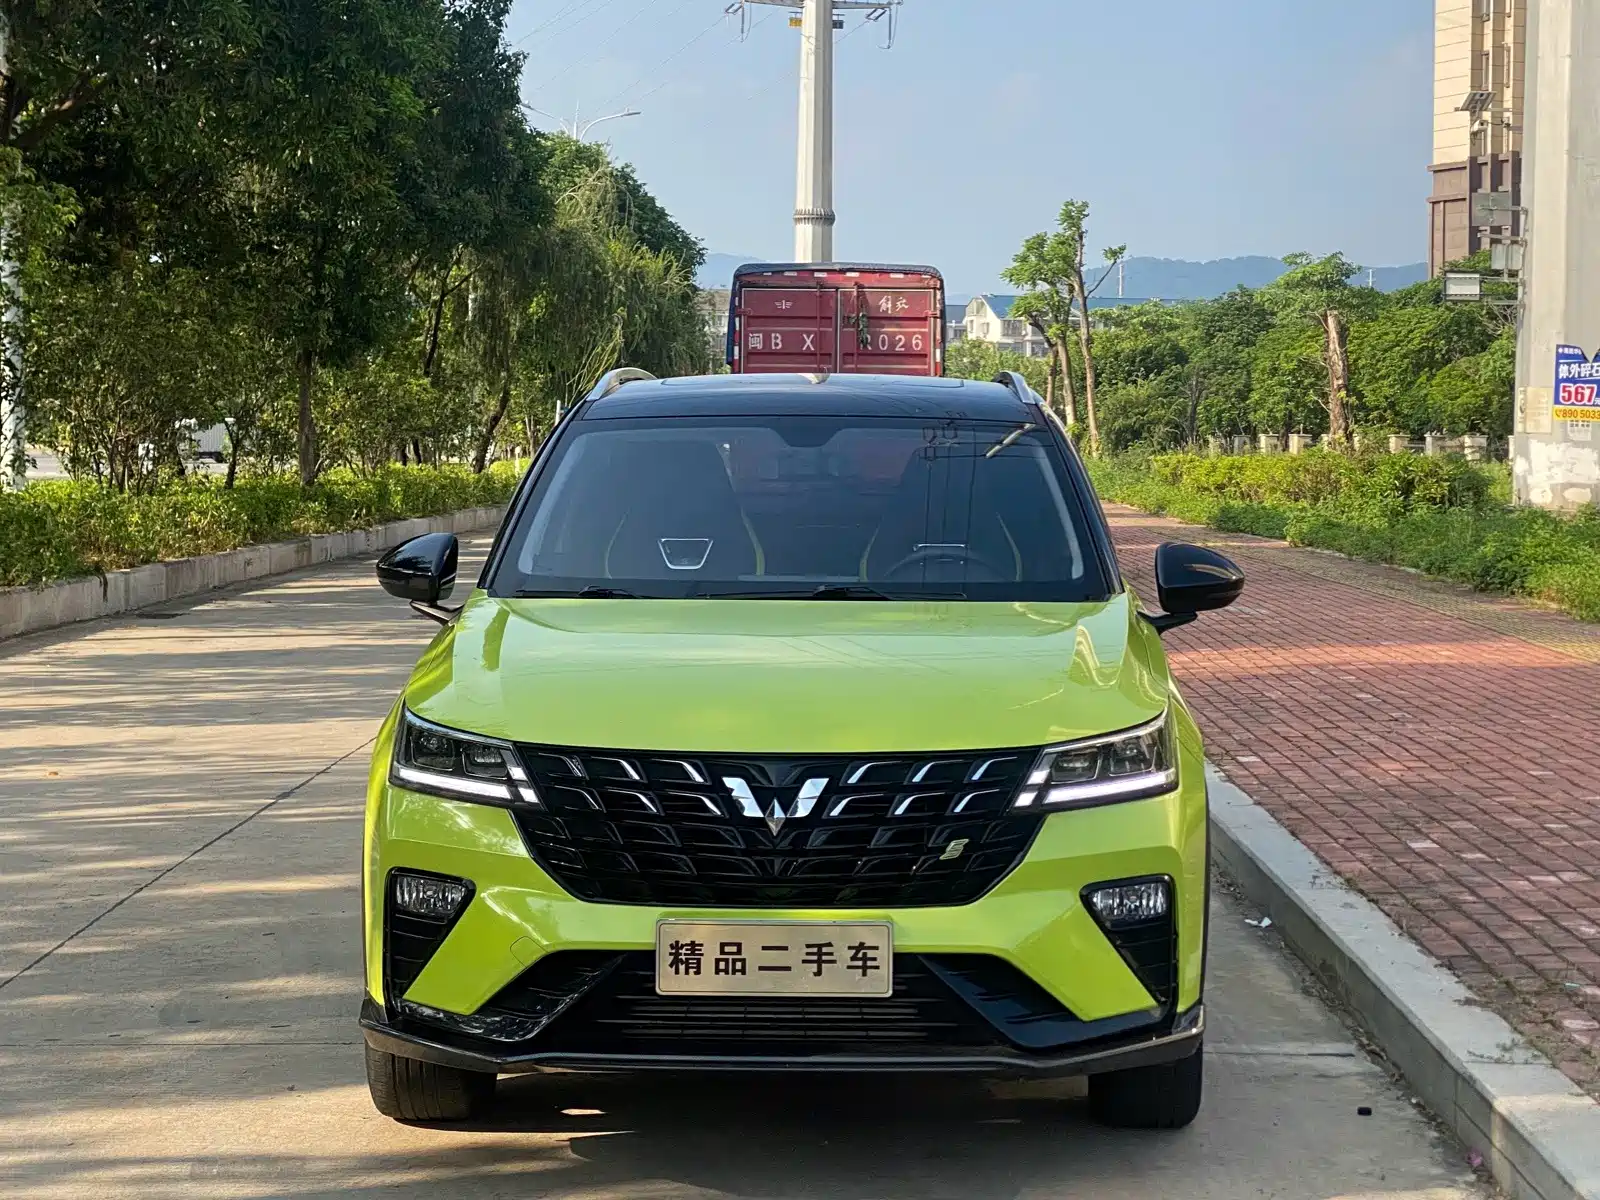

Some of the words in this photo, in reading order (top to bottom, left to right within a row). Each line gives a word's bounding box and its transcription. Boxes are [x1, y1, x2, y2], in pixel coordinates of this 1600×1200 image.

[1560, 383, 1597, 405] 567
[668, 940, 881, 977] 精品二手车
